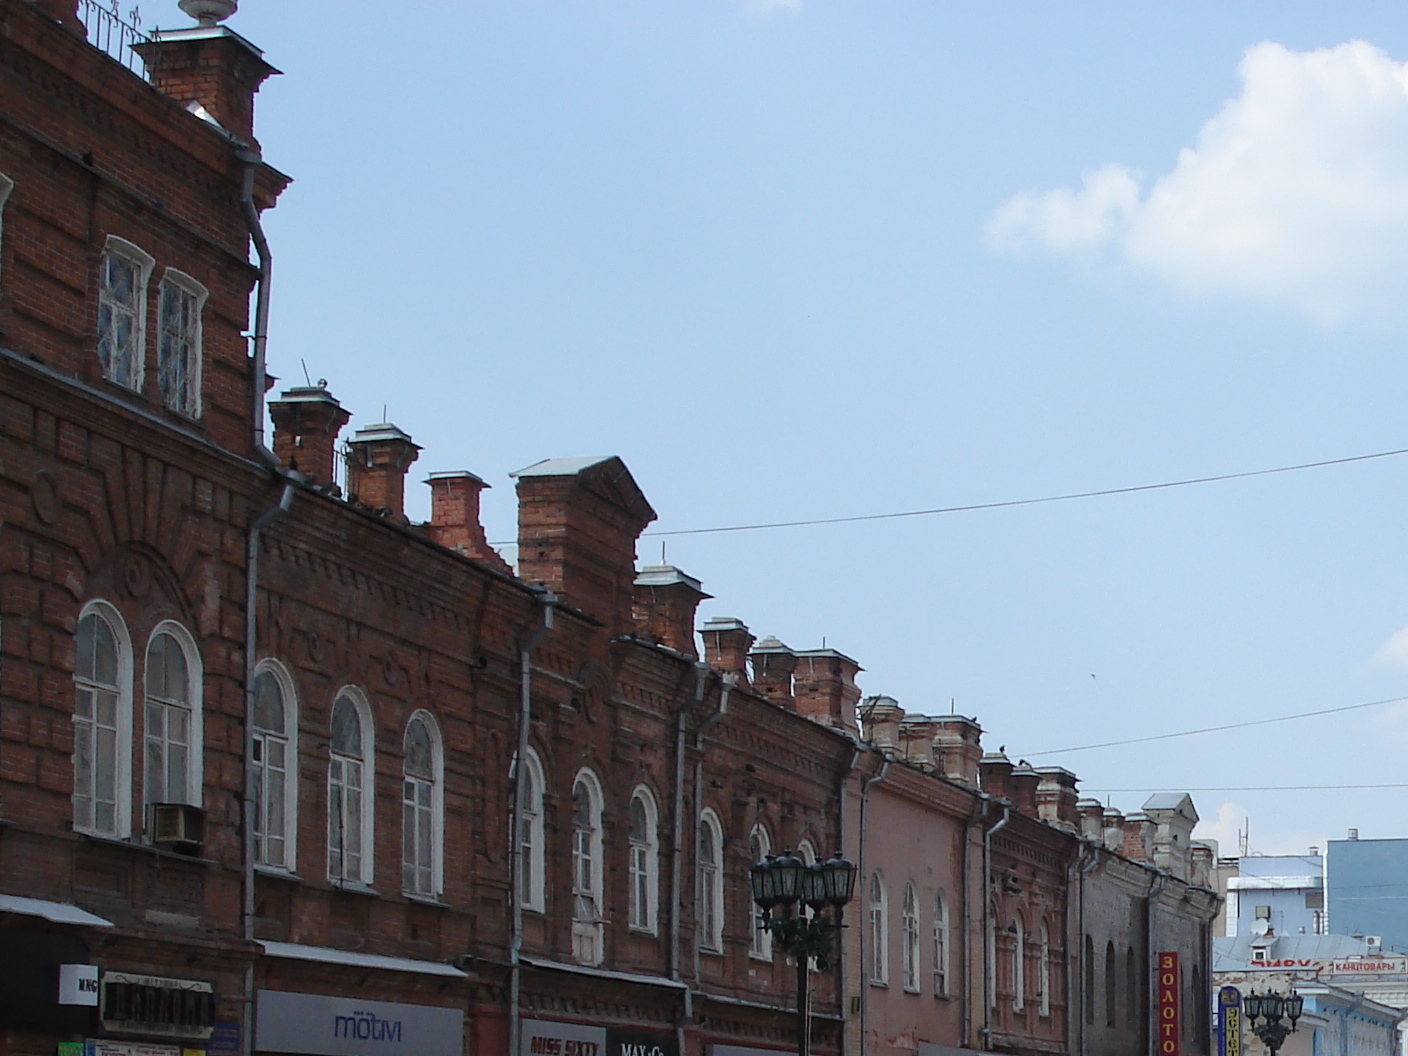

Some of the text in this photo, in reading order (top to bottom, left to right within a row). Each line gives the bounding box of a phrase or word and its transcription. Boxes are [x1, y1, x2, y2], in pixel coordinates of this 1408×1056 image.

[1335, 962, 1395, 971] КАНЦТОВАРЫ
[1162, 956, 1176, 1053] ЗОЛОТО
[530, 1036, 561, 1056] MISS
